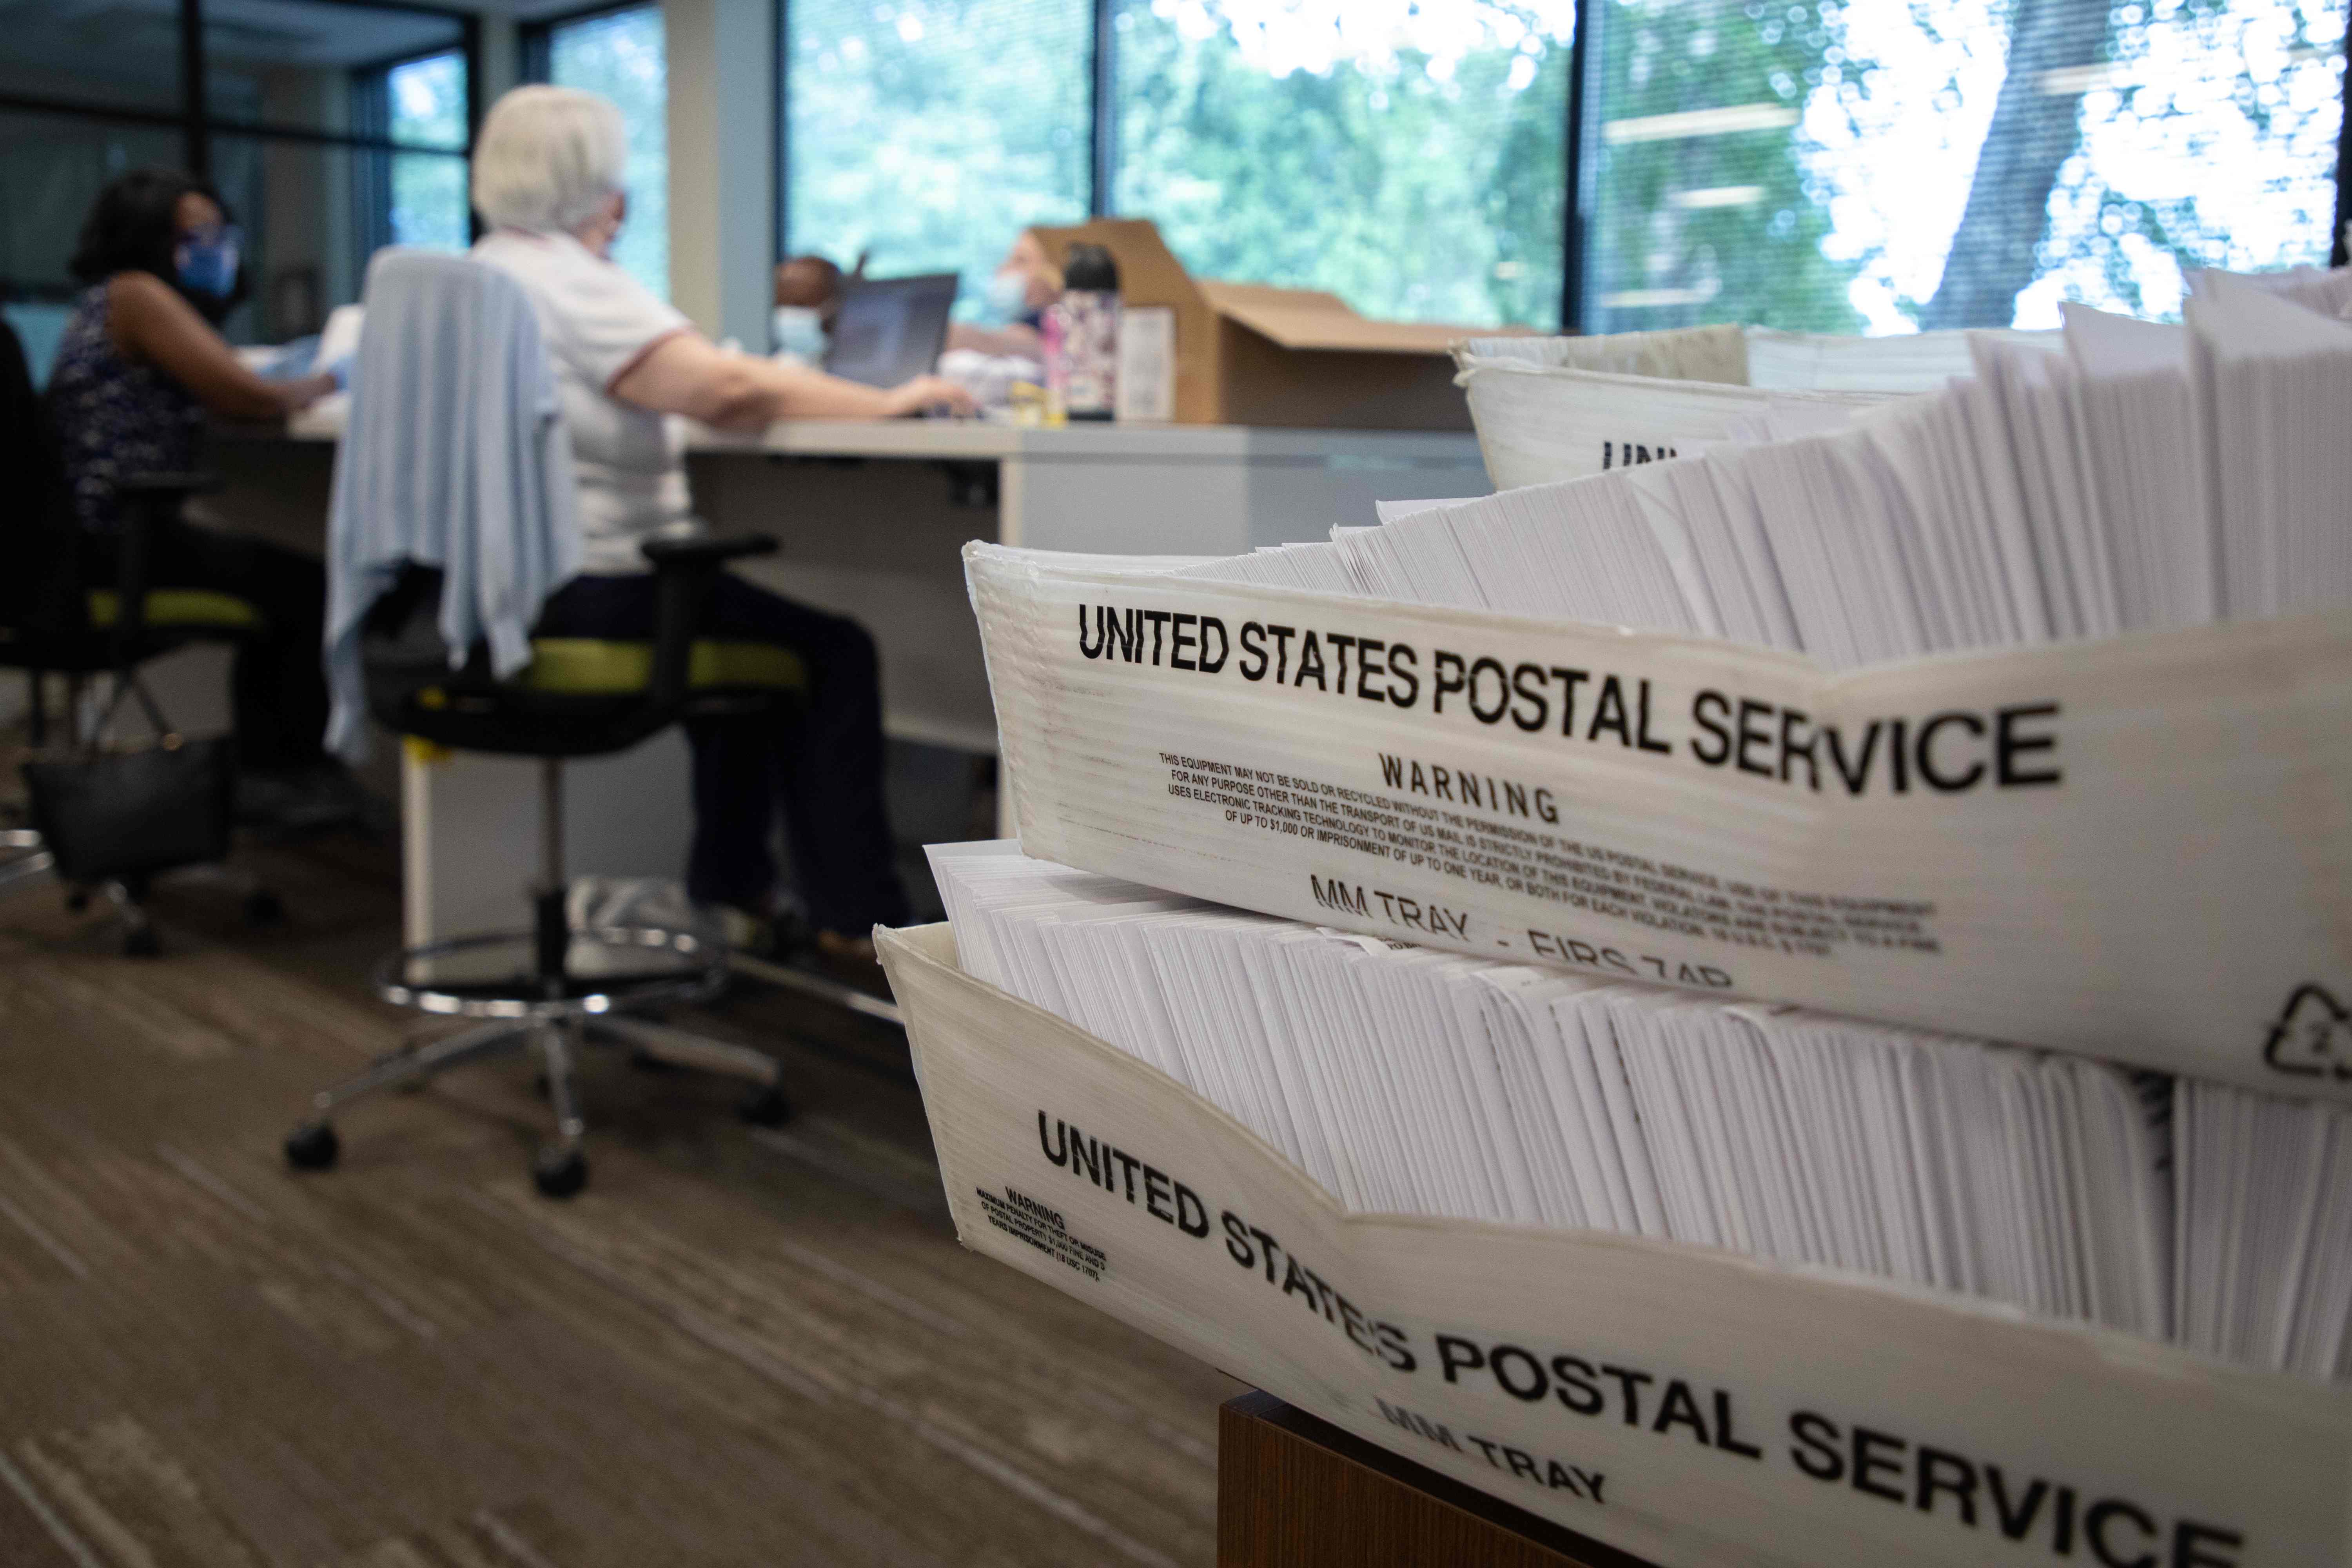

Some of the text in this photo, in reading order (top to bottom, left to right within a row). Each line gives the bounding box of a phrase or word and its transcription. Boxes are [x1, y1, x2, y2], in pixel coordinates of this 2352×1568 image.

[1079, 604, 2063, 797] UNITED STATES POSTAL SERVICE
[1159, 753, 1179, 766] THIS
[1181, 757, 1231, 776] EQUIPMENT
[1234, 766, 1253, 780] MAY
[1256, 771, 1275, 784] NOT
[1277, 775, 1290, 788] BE
[1293, 778, 1319, 793] SOLD
[1321, 784, 1336, 797] OR
[1338, 787, 1394, 810] RECYCLED
[1393, 800, 1439, 821] WITHOUT
[1442, 811, 1464, 828] THE
[1466, 817, 1537, 843] PERMISSION
[1171, 769, 1189, 782] FOR
[1192, 774, 1211, 787] ANY
[1212, 777, 1254, 795] PURPOSE
[1257, 786, 1289, 803] OTHER
[1291, 793, 1317, 809] THAN
[1319, 799, 1338, 813] THE
[1340, 804, 1399, 828] TRANSPORT
[1403, 819, 1417, 831] OF
[1420, 823, 1435, 837] US
[1436, 828, 1463, 844] MAIL
[1465, 834, 1476, 847] IS
[1378, 752, 1559, 824] WARNING
[1168, 784, 1191, 799] USES
[1194, 789, 1250, 810] ELECTRONIC
[1253, 801, 1301, 821] TRACKING
[1303, 811, 1369, 837] TECHNOLOGY
[1372, 827, 1386, 841] TO
[1388, 831, 1435, 854] MONITOR
[1439, 843, 1460, 860] THE
[1463, 851, 1521, 874] LOCATION
[1523, 864, 1538, 879] OF
[1225, 809, 1238, 822] OF
[1240, 813, 1253, 825] UP
[1255, 816, 1268, 828] TO
[1270, 819, 1298, 836] $1,000
[1301, 826, 1314, 839] OR
[1317, 829, 1390, 858] IMPRISONMENT
[1394, 848, 1407, 862] OF
[1410, 851, 1424, 865] UP
[1427, 857, 1441, 871] TO
[1444, 861, 1467, 879] ONE
[1506, 877, 1524, 891] OR
[1311, 874, 1374, 919] MM
[1374, 890, 1471, 942] TRAY
[976, 1187, 1107, 1261] MAXIMUM PENALTY FOR THEFT OR MISUSE
[981, 1201, 989, 1211] OF
[991, 1205, 1013, 1225] POSTAL
[1014, 1218, 1048, 1241] PROPERTY
[1069, 1245, 1084, 1261] FINE
[1085, 1254, 1099, 1268] AND
[988, 1214, 1008, 1232] YEARS
[1008, 1226, 1055, 1258] IMPRISONMENT
[1066, 1256, 1080, 1271] USC
[1005, 1186, 1065, 1230] WARNING
[1038, 1110, 2246, 1568] UNITED STATES POSTAL SERVICE
[1374, 1396, 1606, 1504] MM TRAY
